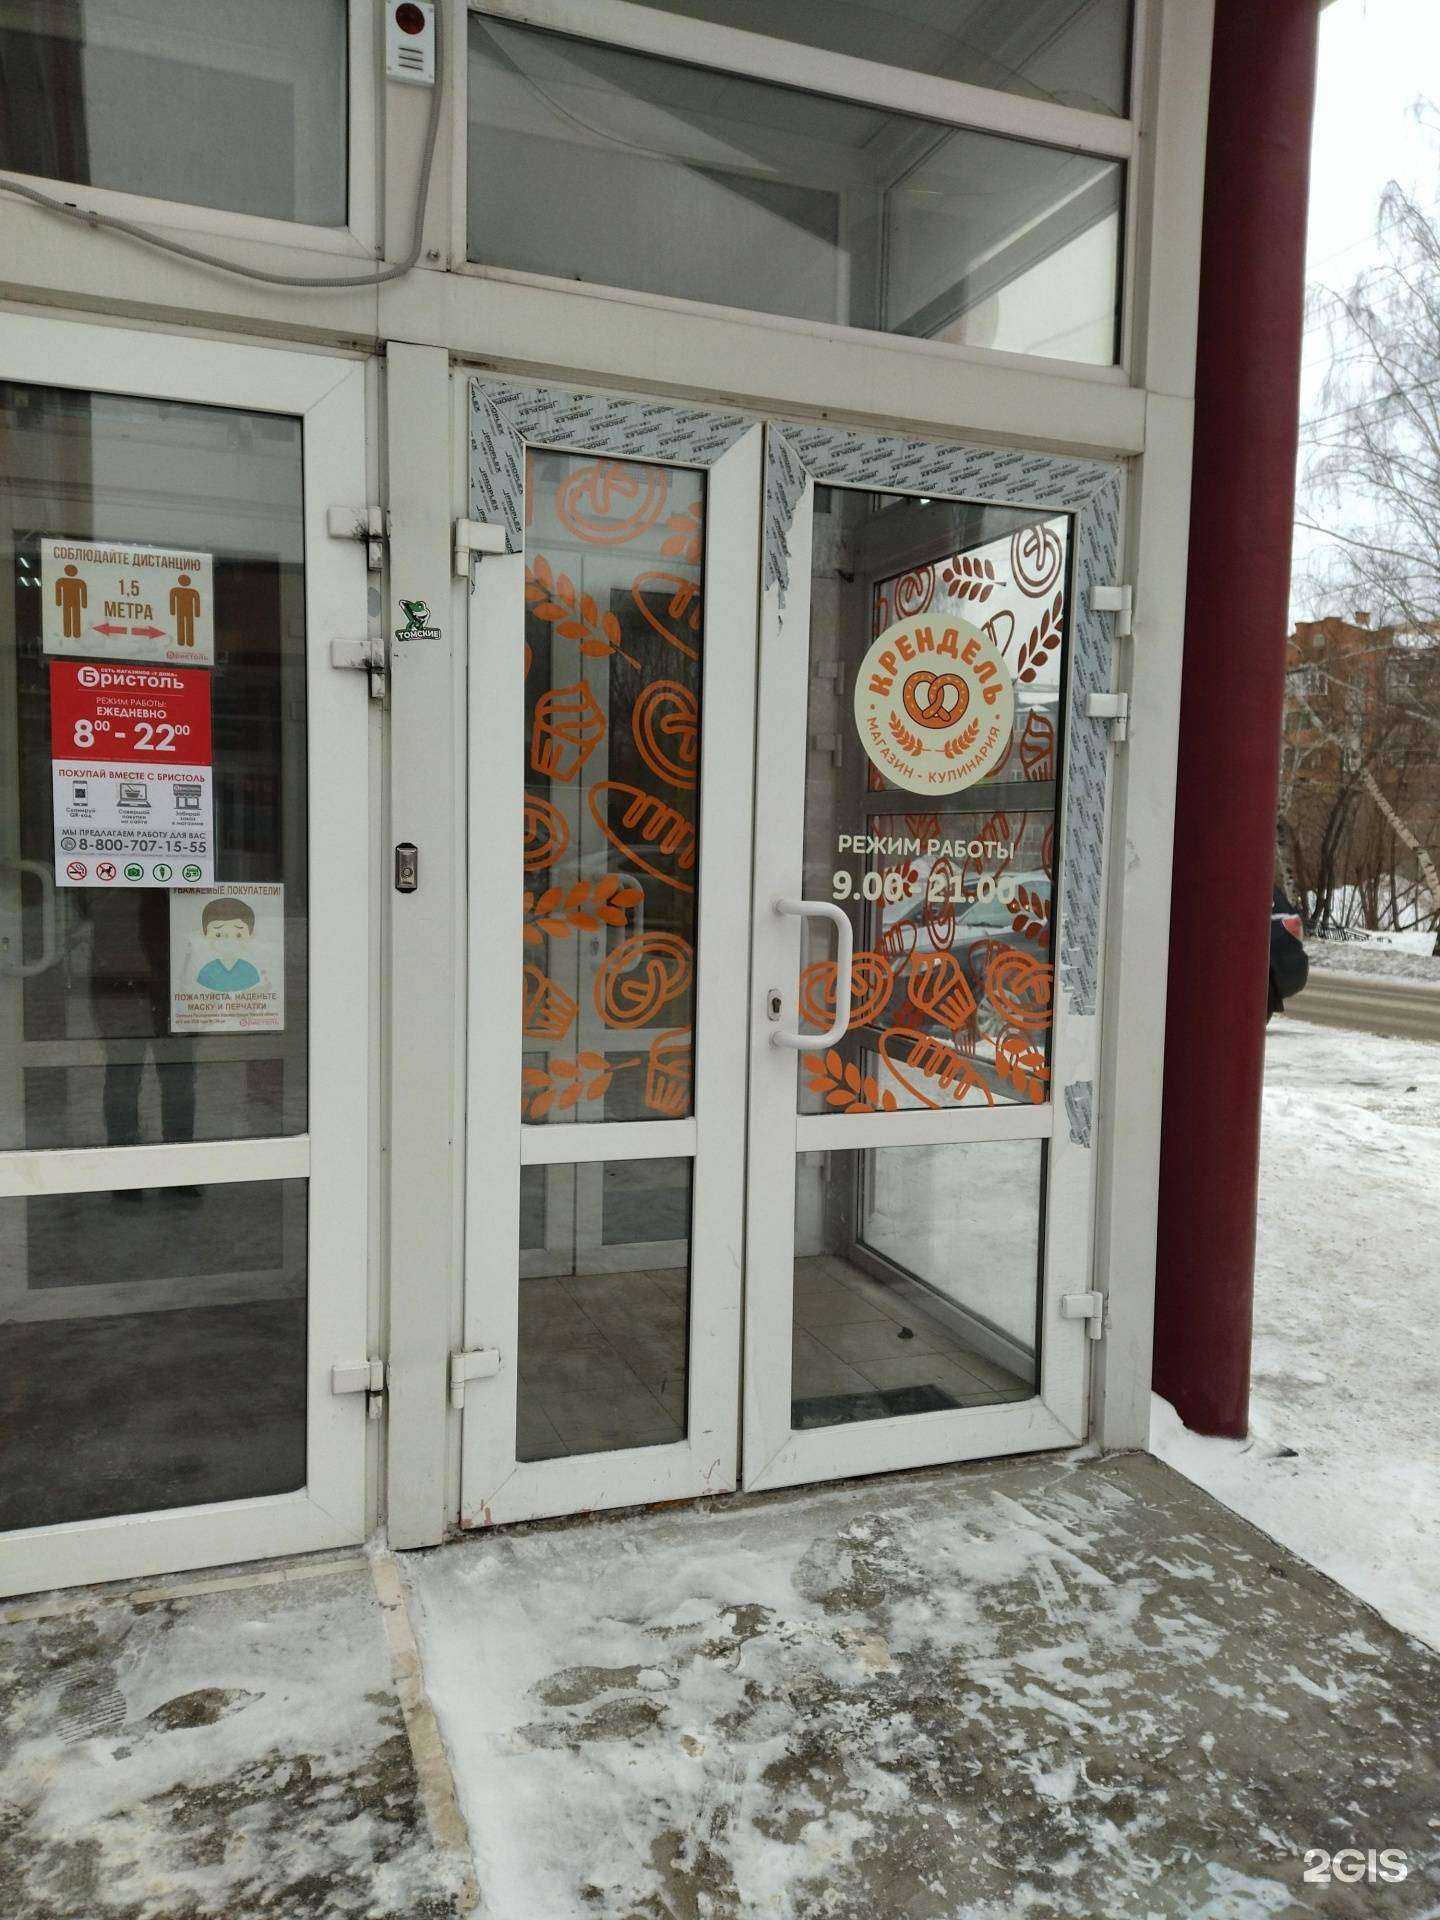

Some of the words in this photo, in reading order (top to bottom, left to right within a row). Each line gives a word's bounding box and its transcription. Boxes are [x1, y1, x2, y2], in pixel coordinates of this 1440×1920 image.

[53, 546, 129, 565] СОБЛЮДАЙТЕ
[132, 553, 201, 571] ДИСТАНЦИЮ
[118, 578, 140, 598] 1,5
[104, 601, 154, 621] МЕТРА
[869, 626, 1004, 705] КРЕНДЕЛЬ
[96, 697, 128, 706] РЕЖИМ
[96, 706, 167, 719] ЕЖЕДНЕВНО
[867, 716, 914, 779] МАГАЗИН
[928, 726, 1000, 784] КУЛИНАРИЯ
[58, 769, 106, 779] ПОКУПАЙ
[109, 771, 145, 781] ВМЕСТЕ
[147, 772, 155, 781] С
[157, 774, 205, 783] БРИСТОЛЬ
[79, 829, 134, 838] ПРЕДЛАГАЕМ
[136, 831, 168, 840] РАБОТУ
[169, 831, 187, 840] ДЛЯ
[189, 832, 206, 840] ВАС
[78, 838, 207, 853] 8-800-707-15-55
[838, 834, 921, 856] РЕЖИМ
[927, 838, 1015, 859] РАБОТЫ
[188, 1003, 215, 1011] МАСКУ
[225, 1003, 267, 1011] ПЕРЧАТКИ
